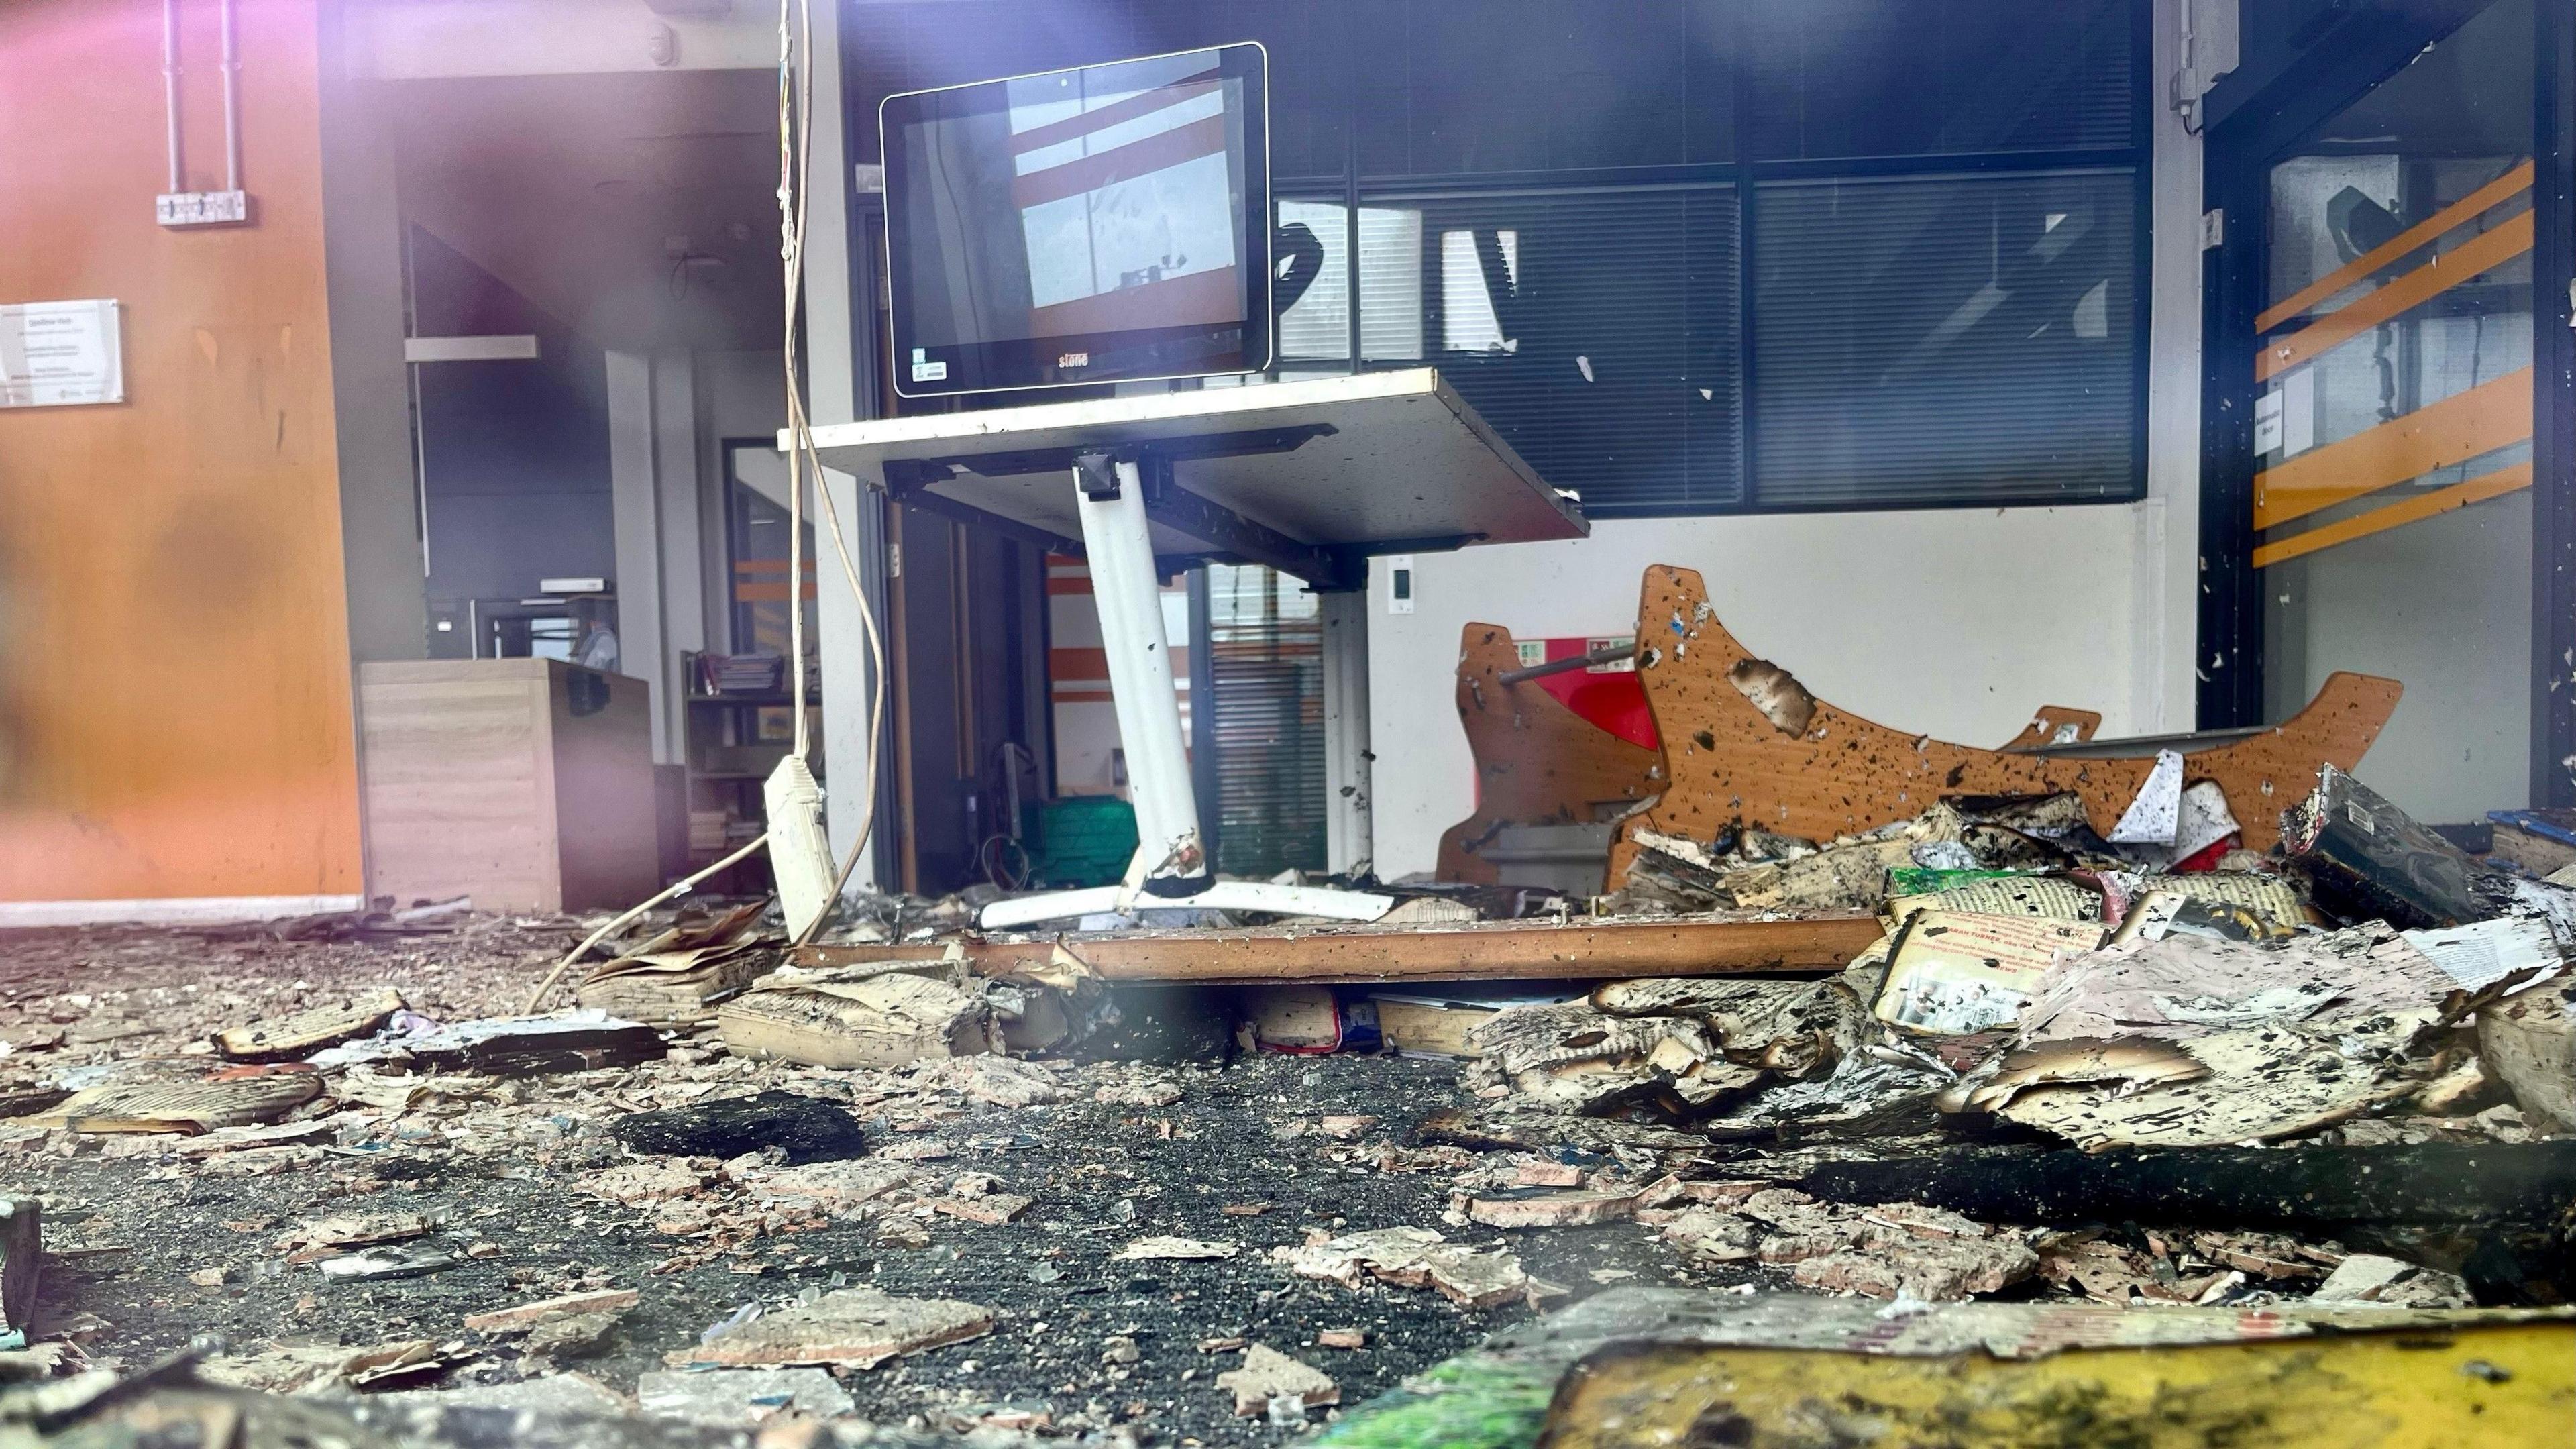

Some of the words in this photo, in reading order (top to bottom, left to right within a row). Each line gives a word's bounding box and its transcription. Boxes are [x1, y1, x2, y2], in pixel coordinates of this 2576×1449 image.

[1059, 353, 1088, 368] stone
[1948, 927, 1970, 936] ARAH
[1996, 965, 2018, 973] REWS
